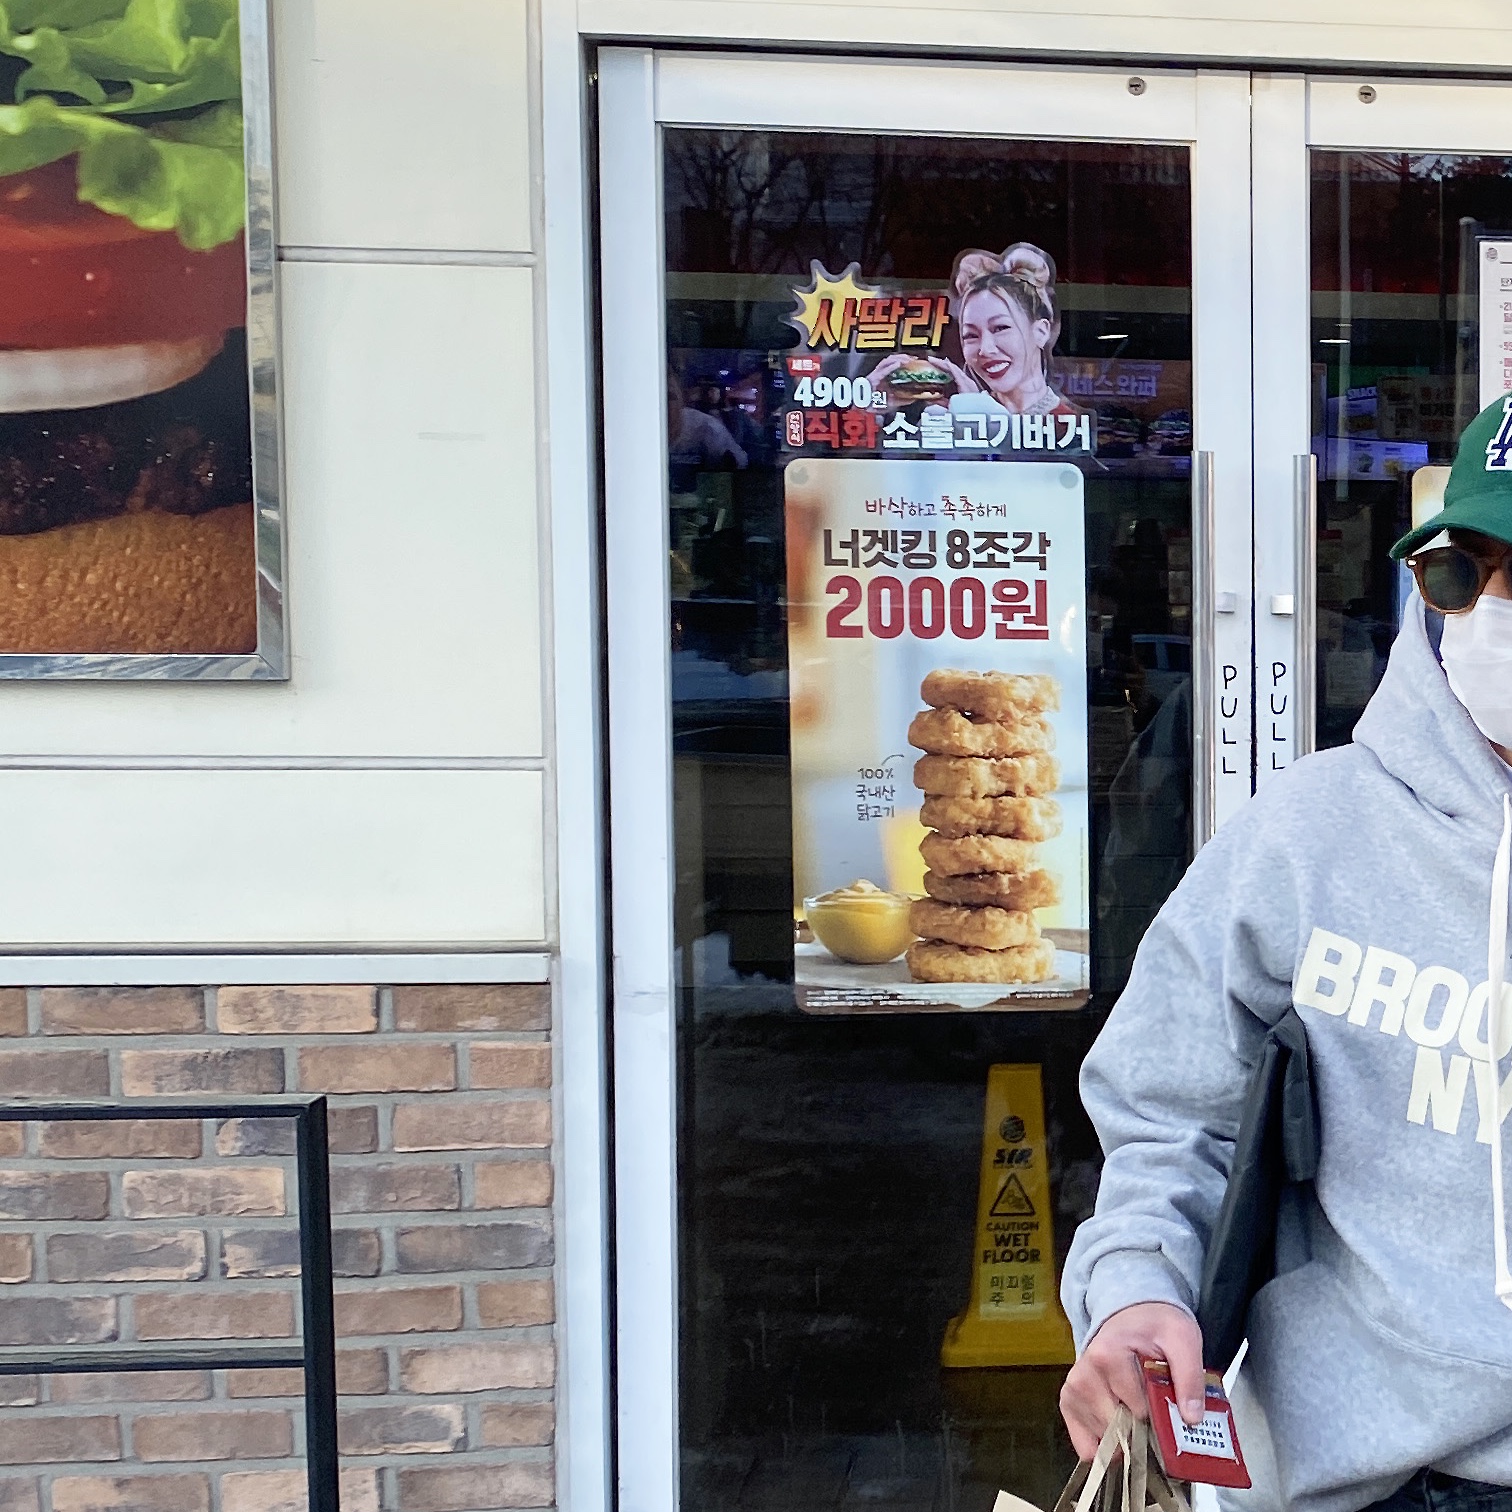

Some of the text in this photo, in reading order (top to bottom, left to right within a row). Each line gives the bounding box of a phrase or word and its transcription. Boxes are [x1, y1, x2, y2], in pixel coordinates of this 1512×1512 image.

[807, 294, 950, 349] 사딸라
[793, 376, 888, 409] 4900원
[805, 410, 879, 449] 직화
[883, 412, 1091, 450] 소불고기버거
[865, 494, 1007, 520] 바삭하고 촉촉하게
[823, 528, 1051, 571] 너겟킹 8조각
[825, 575, 1050, 640] 2000원
[1221, 664, 1237, 774] PULL
[1270, 661, 1287, 770] PULL
[855, 784, 896, 802] 국내산
[986, 1221, 1040, 1232] CAUTION
[994, 1233, 1031, 1248] WET
[983, 1250, 1041, 1264] FLOOR
